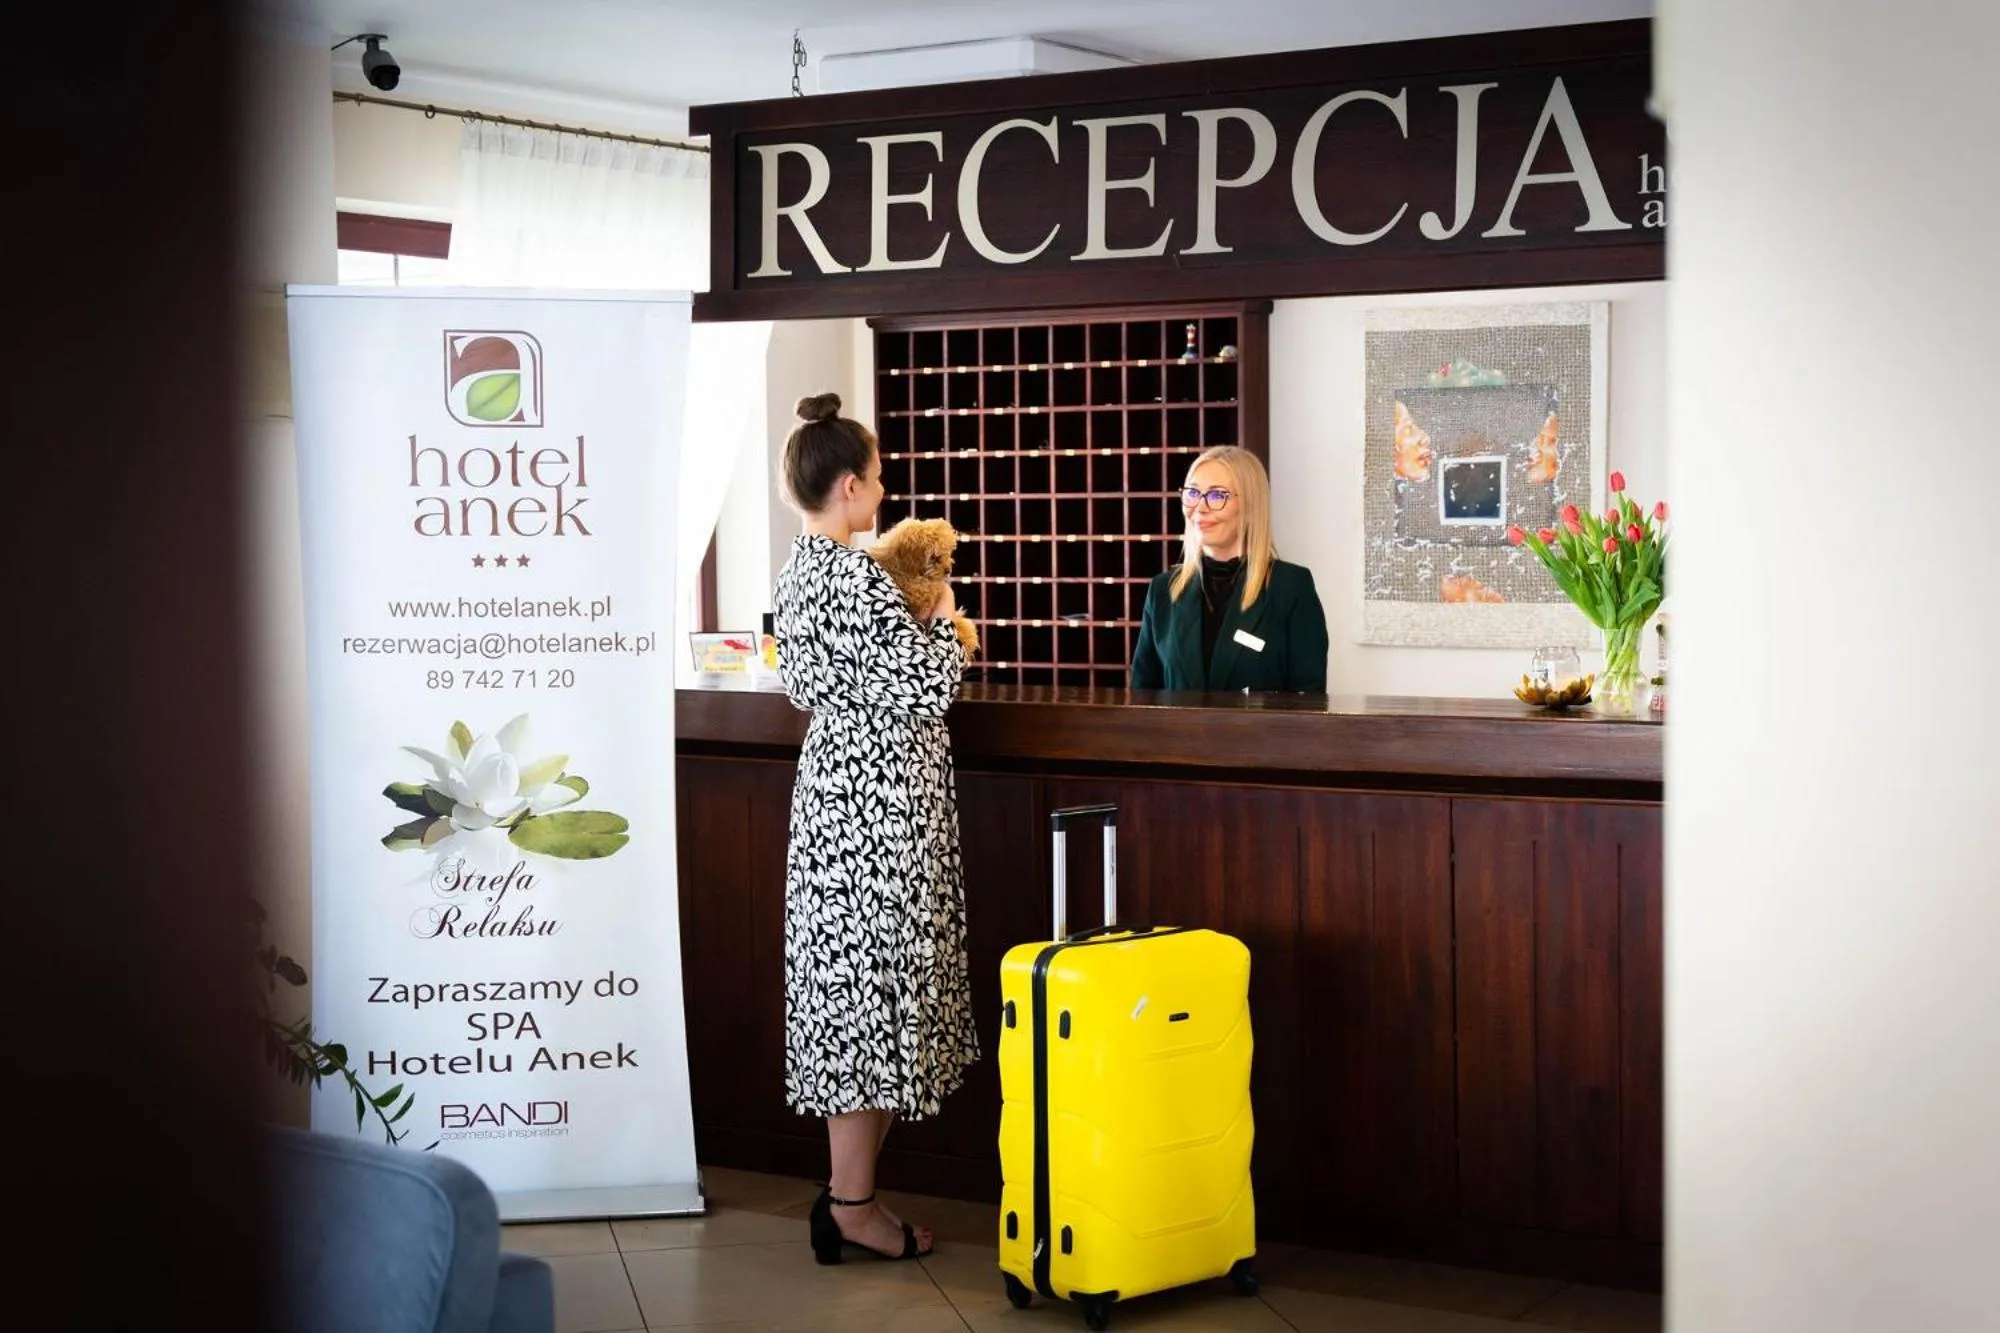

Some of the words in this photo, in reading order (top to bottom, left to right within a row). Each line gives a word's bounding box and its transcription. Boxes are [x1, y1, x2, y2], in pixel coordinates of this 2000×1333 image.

[746, 75, 1633, 278] RECEPCJA
[408, 435, 588, 488] hotel
[413, 485, 593, 537] anek
[388, 596, 612, 621] www.hotelanek.pl
[342, 632, 656, 659] rezerwacja@hotelanek.pl
[426, 671, 454, 689] 89
[462, 670, 504, 689] 742
[512, 670, 538, 688] 71
[548, 669, 575, 688] 20
[431, 858, 541, 906] Strefa
[409, 903, 563, 939] Relaksu
[367, 977, 583, 1009] Zapraszamy
[594, 970, 639, 997] do
[467, 1011, 542, 1041] SPA
[368, 1048, 512, 1076] Hotelu
[528, 1042, 639, 1072] Anek
[440, 1101, 568, 1128] BANDI
[440, 1130, 505, 1141] cosmetics
